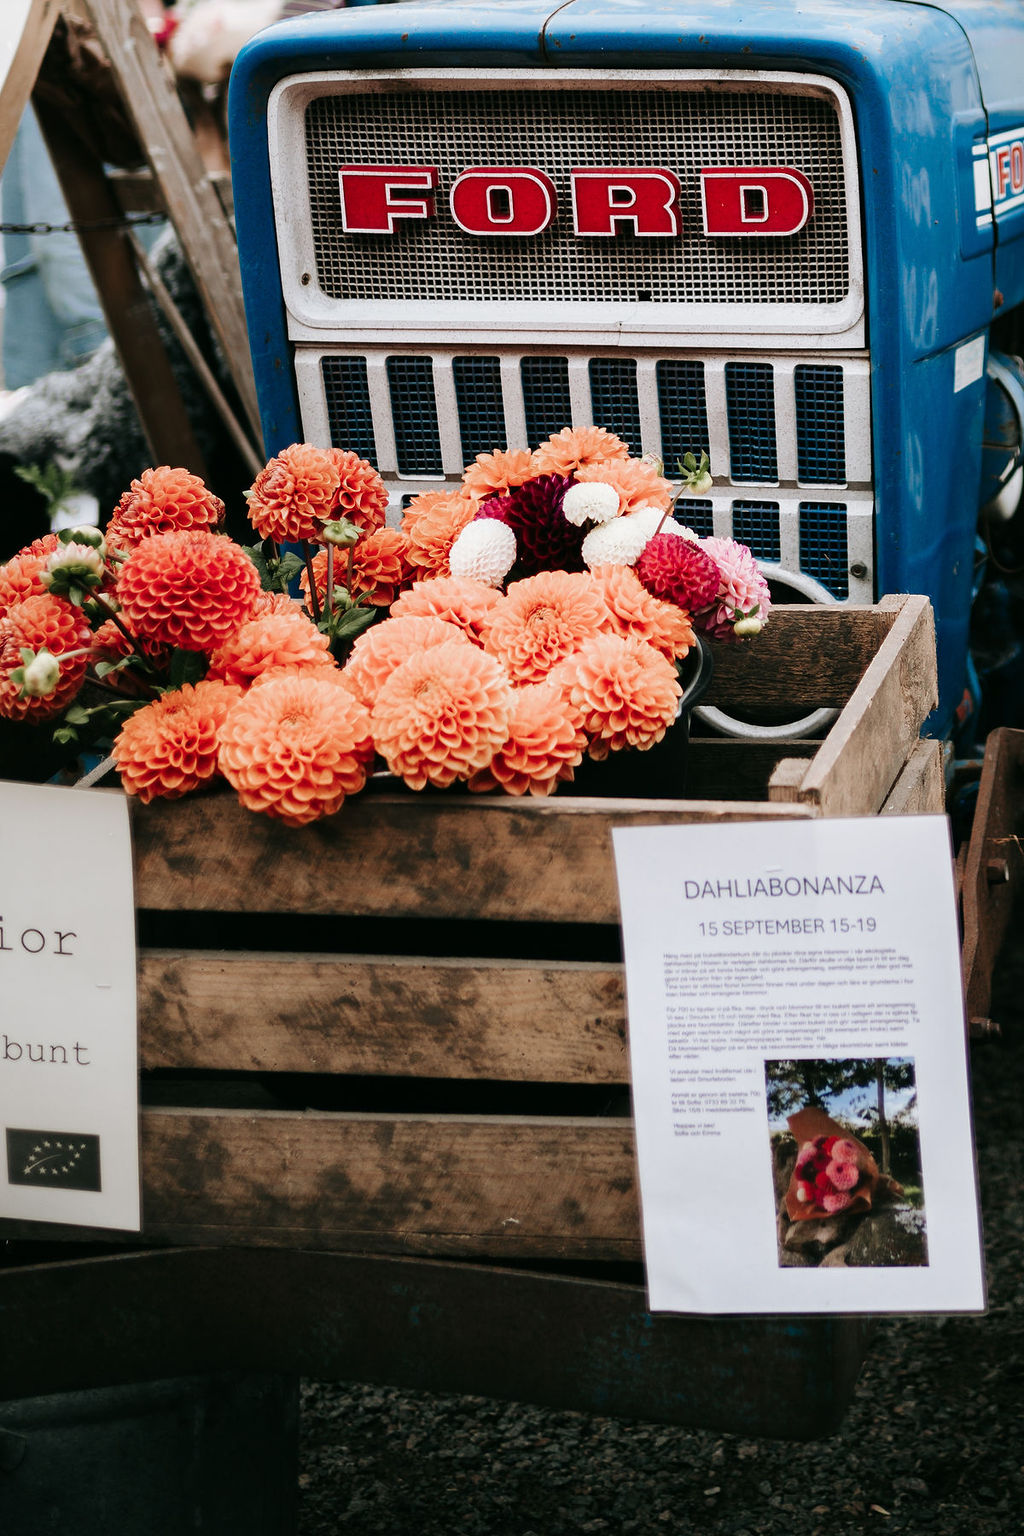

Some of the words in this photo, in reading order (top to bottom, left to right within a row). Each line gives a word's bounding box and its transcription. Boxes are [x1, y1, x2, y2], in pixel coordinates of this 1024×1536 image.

[339, 164, 815, 238] FORD
[684, 875, 885, 899] DAHLIABONANZA
[698, 921, 718, 937] 15
[722, 917, 826, 937] SEPTEMBER
[829, 916, 877, 934] 15-19
[2, 1034, 91, 1066] bunt
